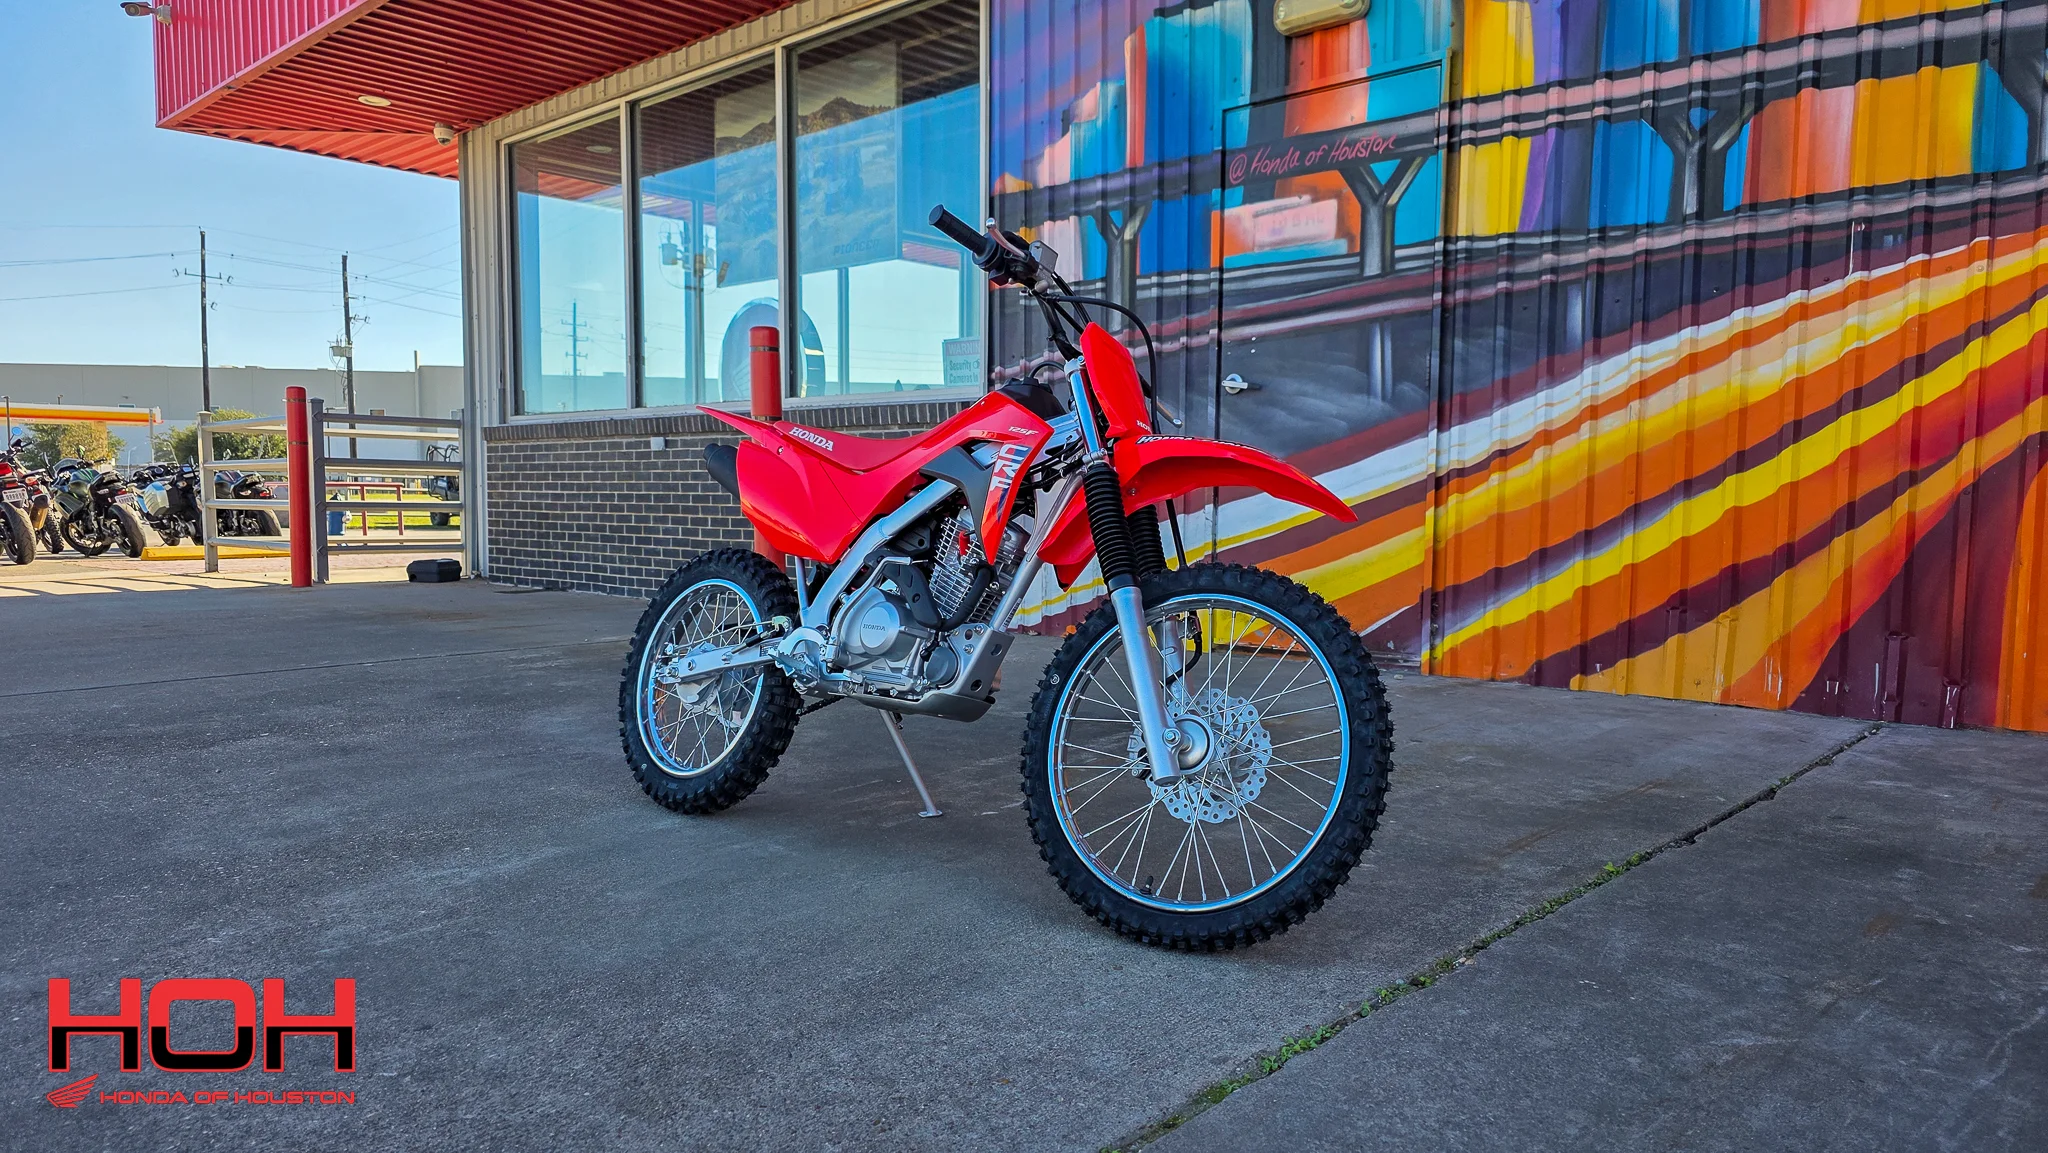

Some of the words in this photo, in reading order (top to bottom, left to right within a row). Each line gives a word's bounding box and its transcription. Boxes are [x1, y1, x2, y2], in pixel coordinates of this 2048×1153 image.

[1250, 146, 1300, 176] Honda
[1304, 145, 1328, 166] of
[1327, 130, 1398, 164] Houston
[948, 342, 980, 355] WARNIN
[949, 359, 972, 371] Security
[949, 373, 973, 383] Cameras
[1008, 426, 1039, 436] 125F
[788, 426, 834, 452] HONDA
[990, 444, 1029, 492] CRF
[862, 623, 886, 632] HONDA
